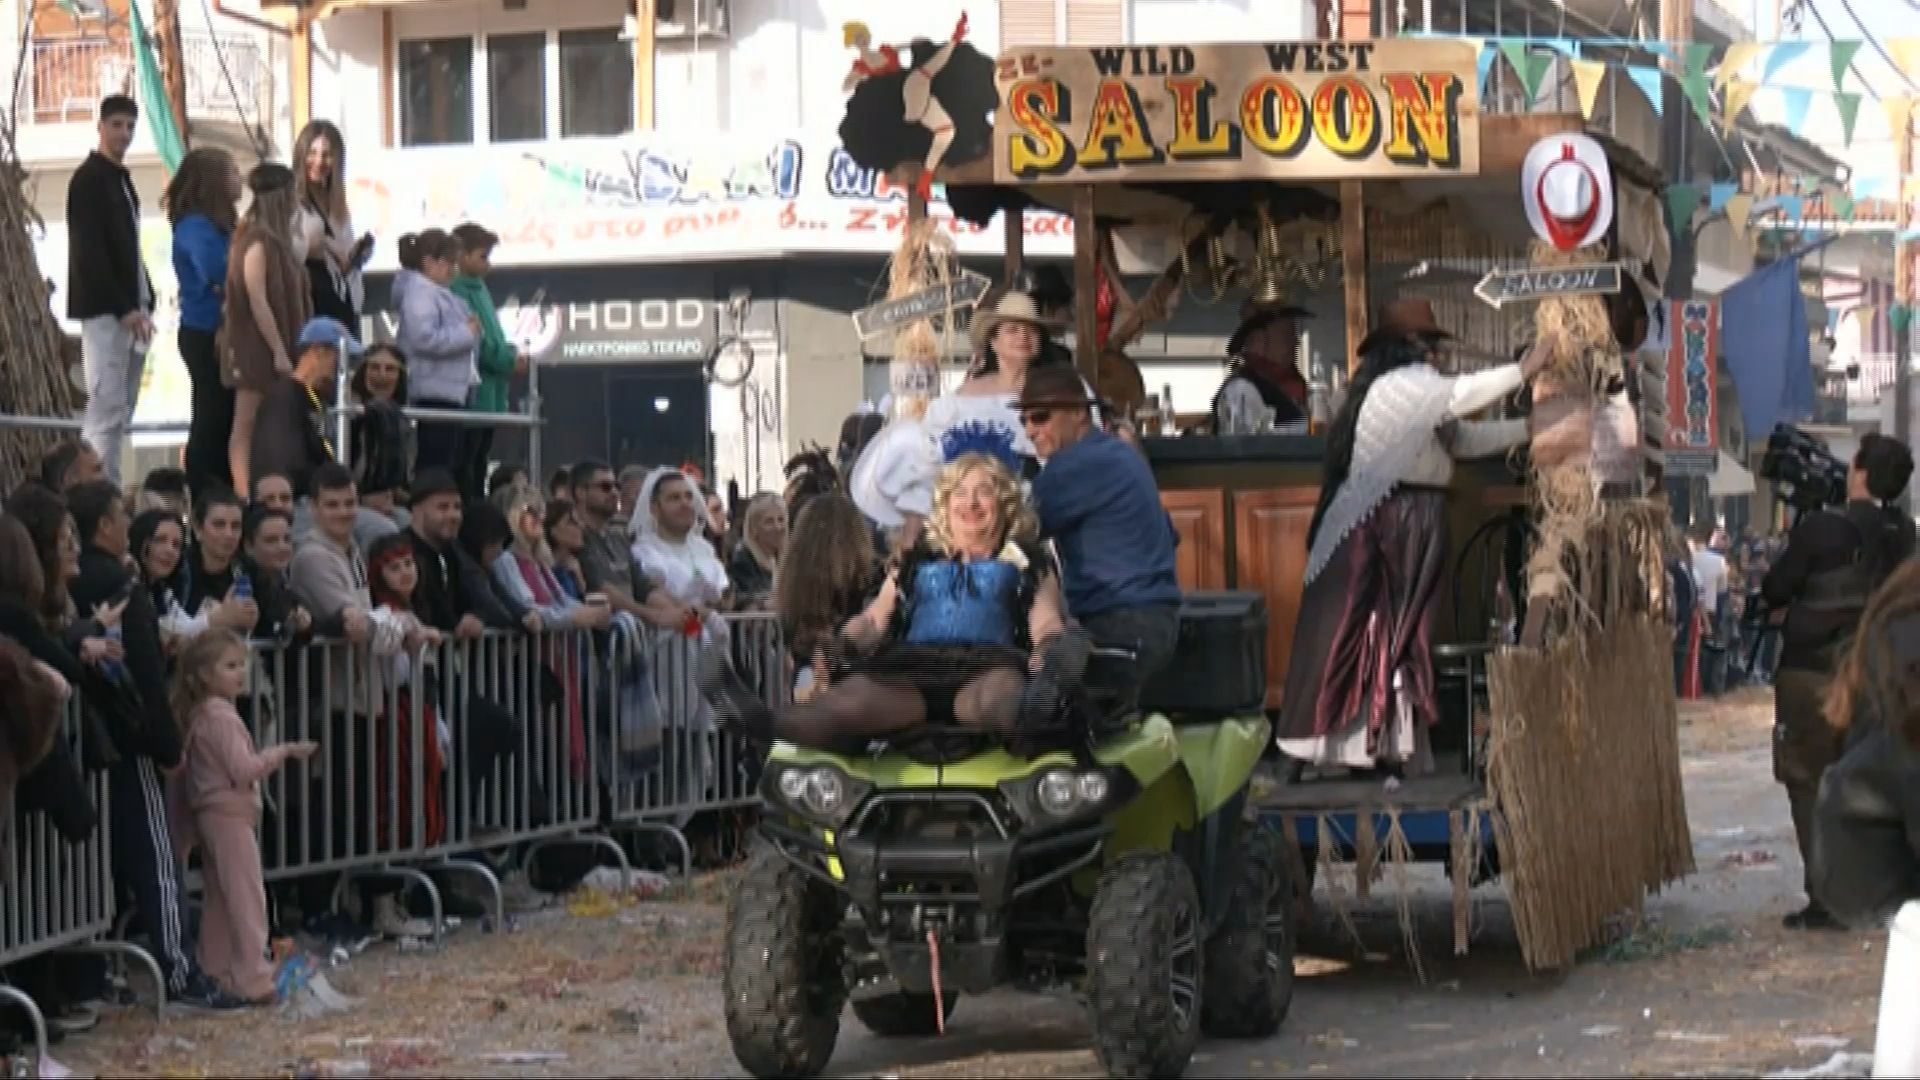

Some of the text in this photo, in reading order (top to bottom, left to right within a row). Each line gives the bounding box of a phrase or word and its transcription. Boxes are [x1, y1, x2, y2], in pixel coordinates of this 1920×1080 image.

[1090, 42, 1375, 76] WILD WEST
[1009, 74, 1464, 178] SALOON
[569, 299, 705, 332] HOOD
